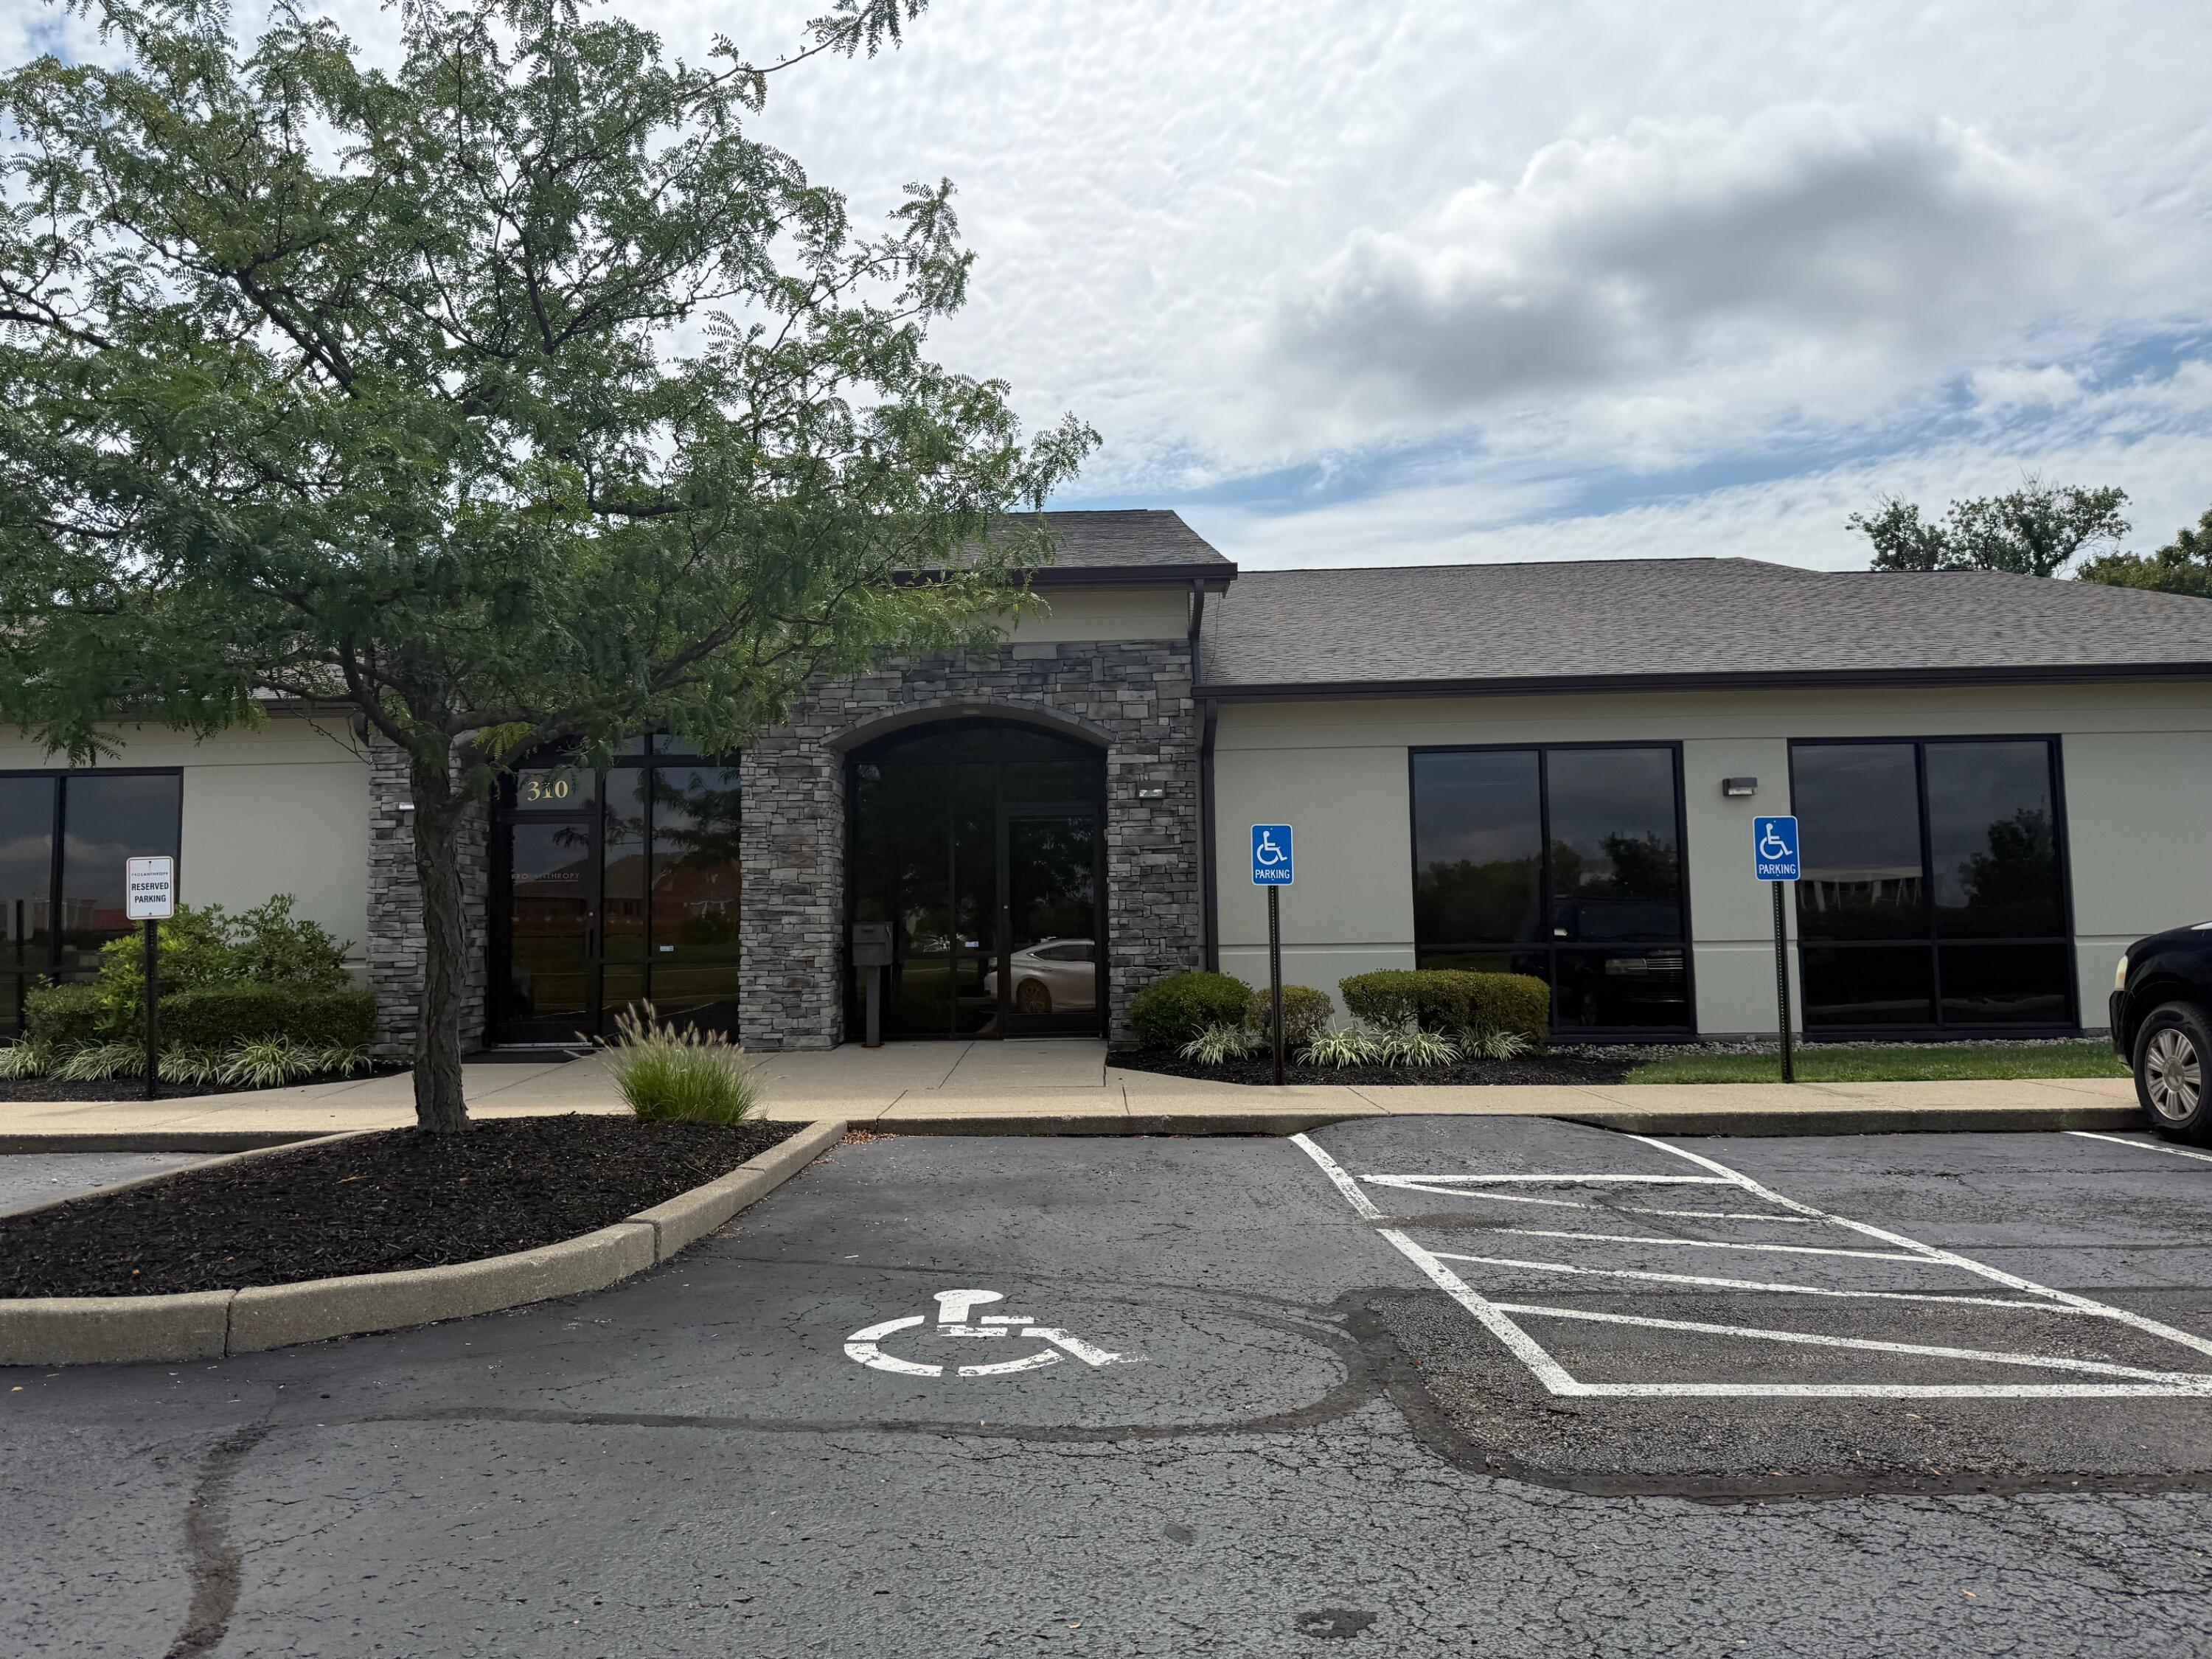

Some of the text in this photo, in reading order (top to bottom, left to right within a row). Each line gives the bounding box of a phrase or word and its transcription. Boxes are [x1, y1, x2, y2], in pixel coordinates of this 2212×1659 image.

[527, 781, 568, 801] 310
[1759, 863, 1796, 874] PARKING
[1255, 869, 1290, 879] PARKING
[131, 882, 170, 891] RESERVED
[134, 894, 167, 903] PARKING
